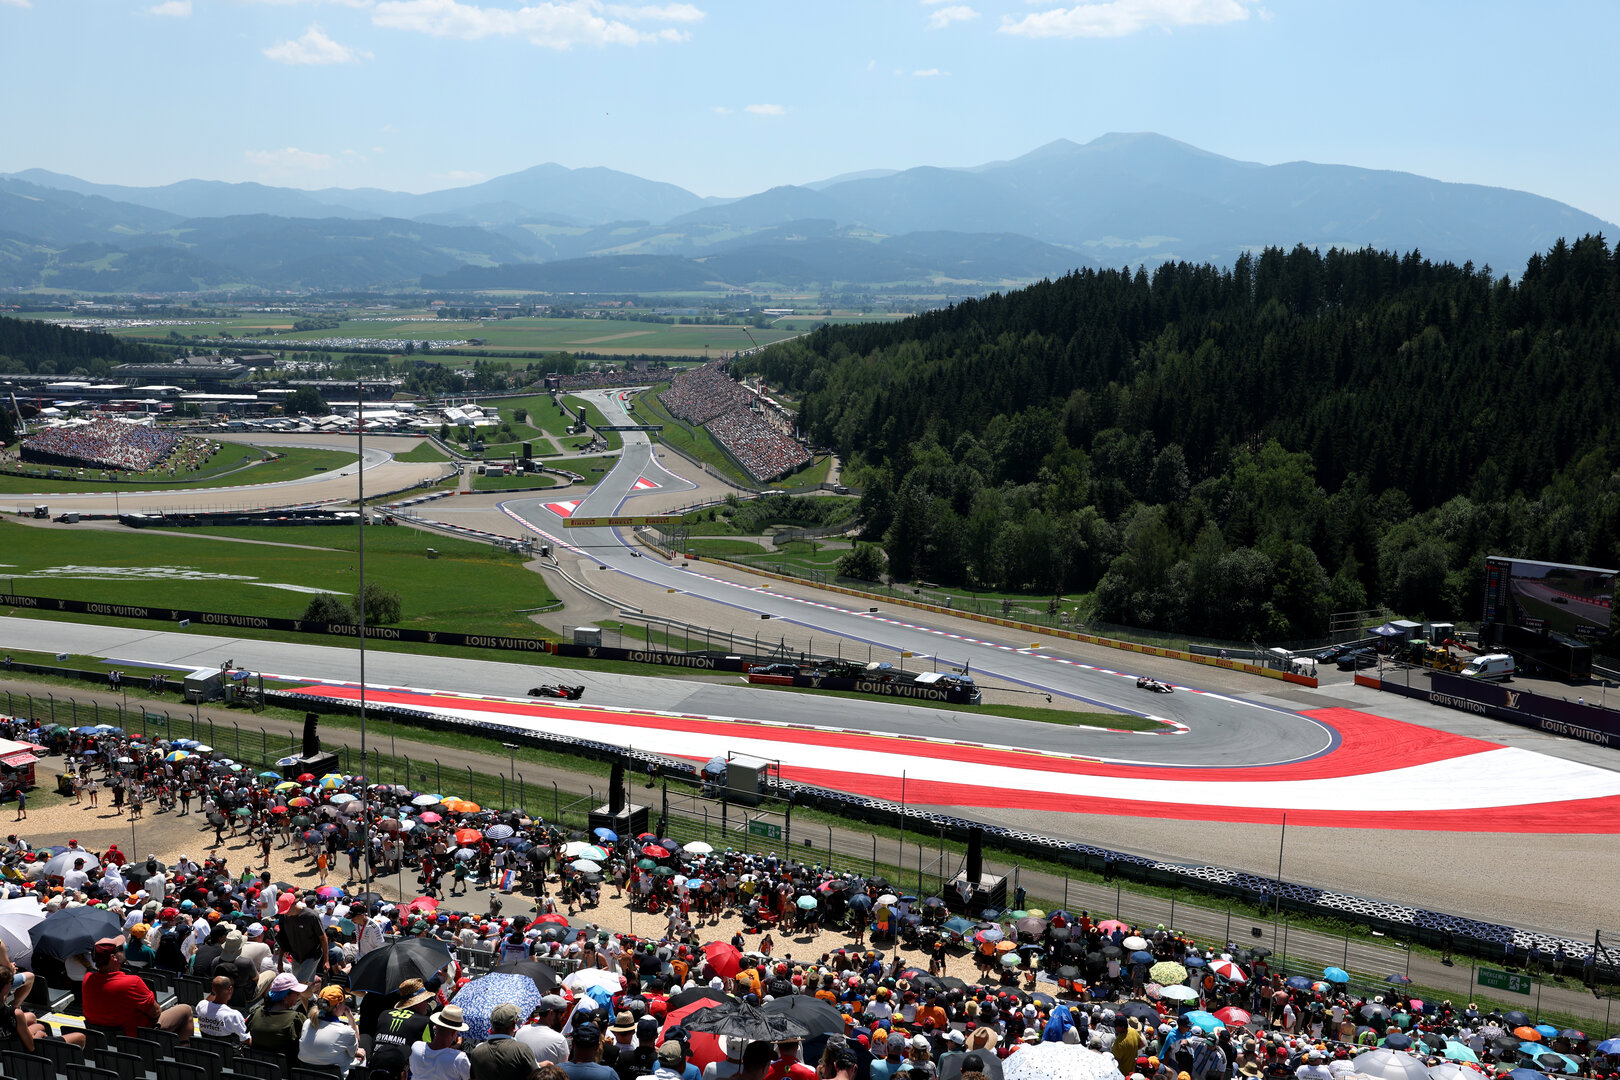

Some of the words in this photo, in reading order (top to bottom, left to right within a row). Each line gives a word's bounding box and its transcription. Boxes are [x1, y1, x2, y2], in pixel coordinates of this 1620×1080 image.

[4, 595, 37, 606] VUITTON
[87, 603, 111, 614] LOUIS
[113, 606, 148, 617] VUITTON
[202, 613, 228, 624] LOUIS
[230, 616, 268, 628] VUITTON
[328, 624, 356, 635] LOUIS
[466, 635, 496, 647] LOUIS
[500, 638, 544, 650] VUITTON
[630, 650, 662, 664] LOUIS
[666, 654, 714, 668] VUITTON
[856, 680, 892, 694] LOUIS
[896, 684, 948, 700] VUITTON
[1430, 692, 1452, 706] LOUIS
[1453, 698, 1486, 714] VUITTON
[1541, 719, 1568, 735] LOUIS
[1570, 726, 1610, 744] VUITTON
[1480, 970, 1507, 980] EMERGENCY
[388, 1010, 414, 1019] 46
[381, 1034, 406, 1045] YAMAHA
